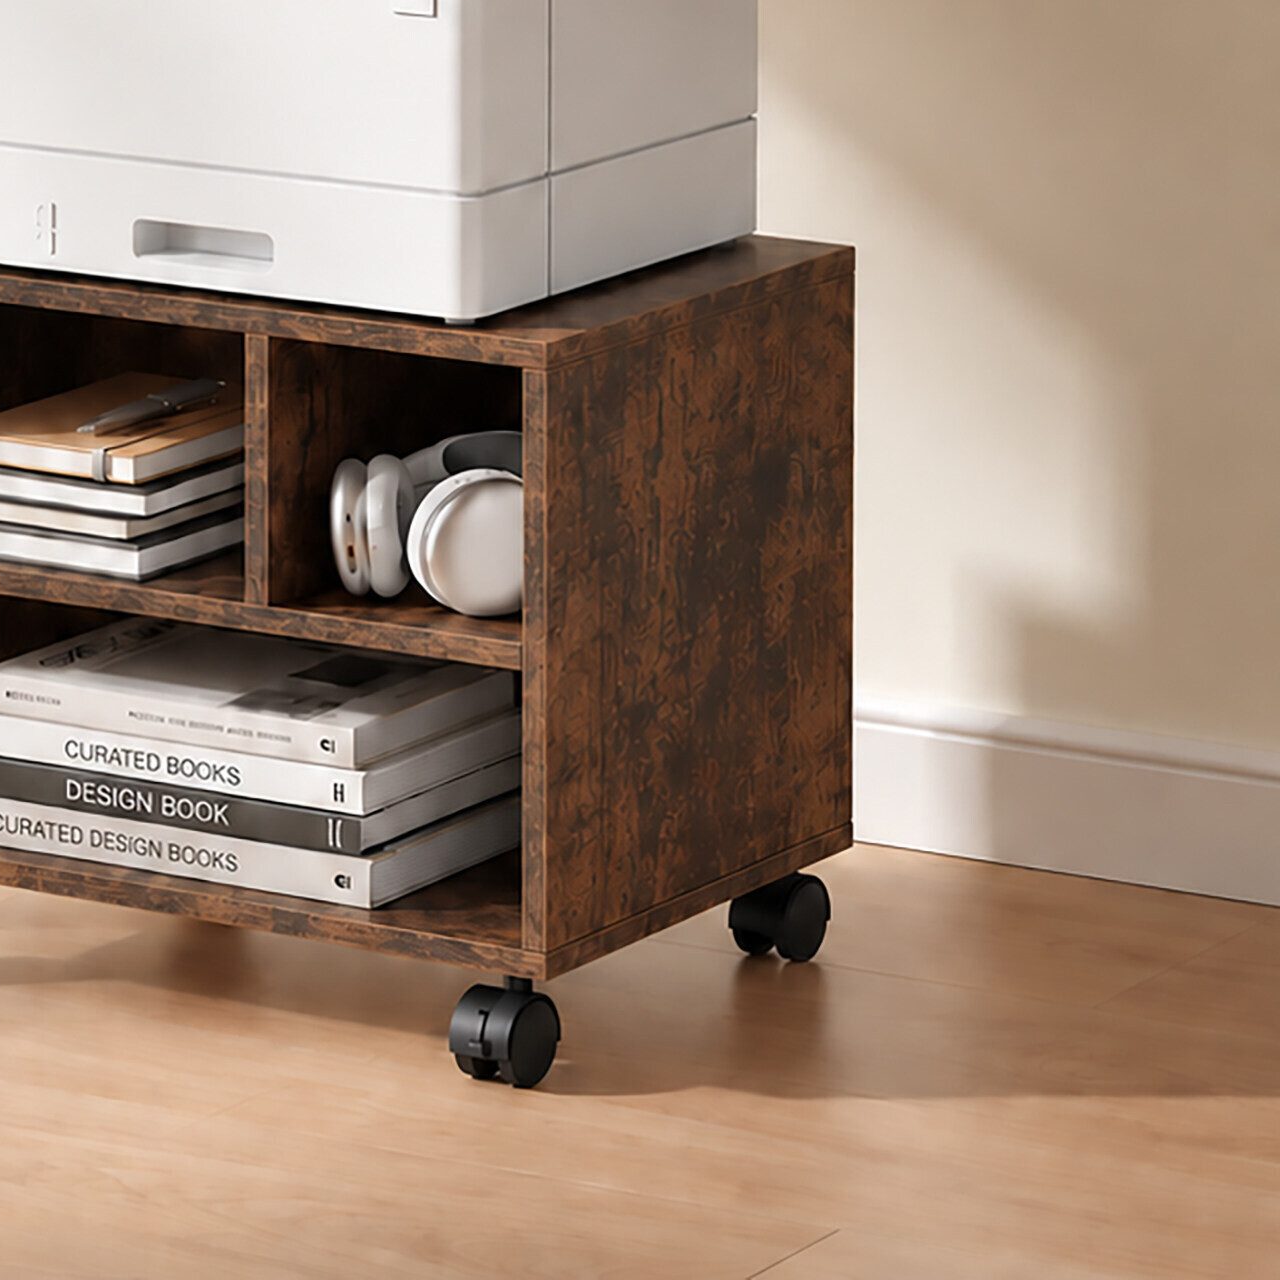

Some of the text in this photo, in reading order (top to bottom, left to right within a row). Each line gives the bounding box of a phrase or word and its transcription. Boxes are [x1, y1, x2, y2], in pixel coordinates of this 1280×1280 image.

[64, 739, 242, 787] CURATED BOOKS
[65, 778, 230, 826] DESIGN BOOK
[89, 829, 163, 859] DESIGN
[168, 843, 239, 872] BOOKS
